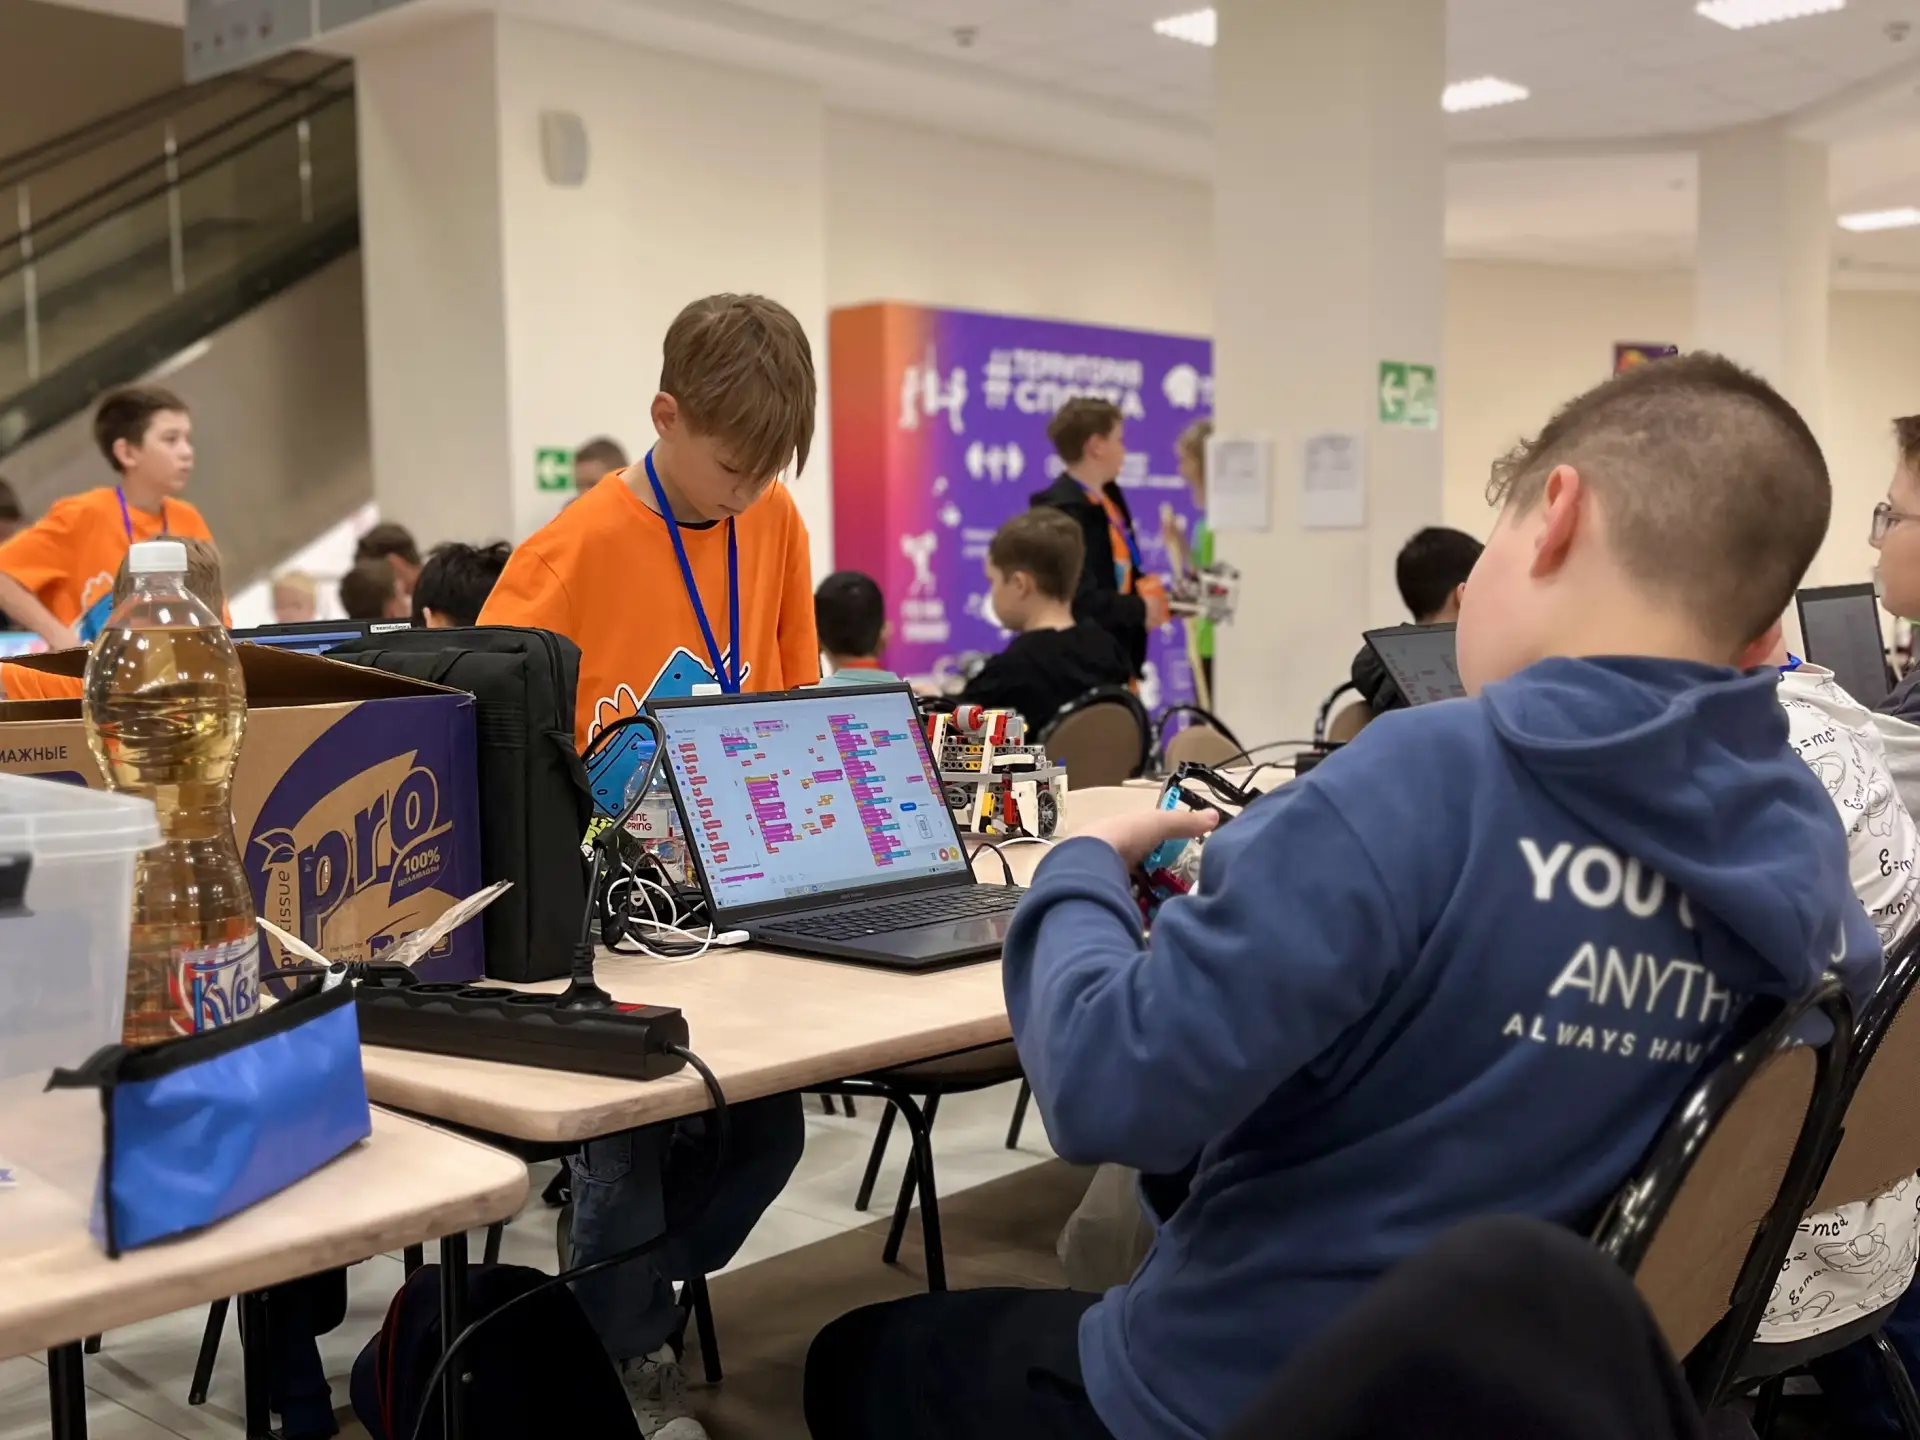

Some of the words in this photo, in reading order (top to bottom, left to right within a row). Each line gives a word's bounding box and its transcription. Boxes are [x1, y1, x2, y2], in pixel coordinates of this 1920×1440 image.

[403, 846, 441, 875] 100%
[1518, 838, 1666, 918] YOU
[276, 869, 297, 969] prtissue
[1547, 942, 1734, 1024] ANYTH
[1502, 1013, 1637, 1056] ALWAYS
[1648, 1036, 1718, 1064] HAV
